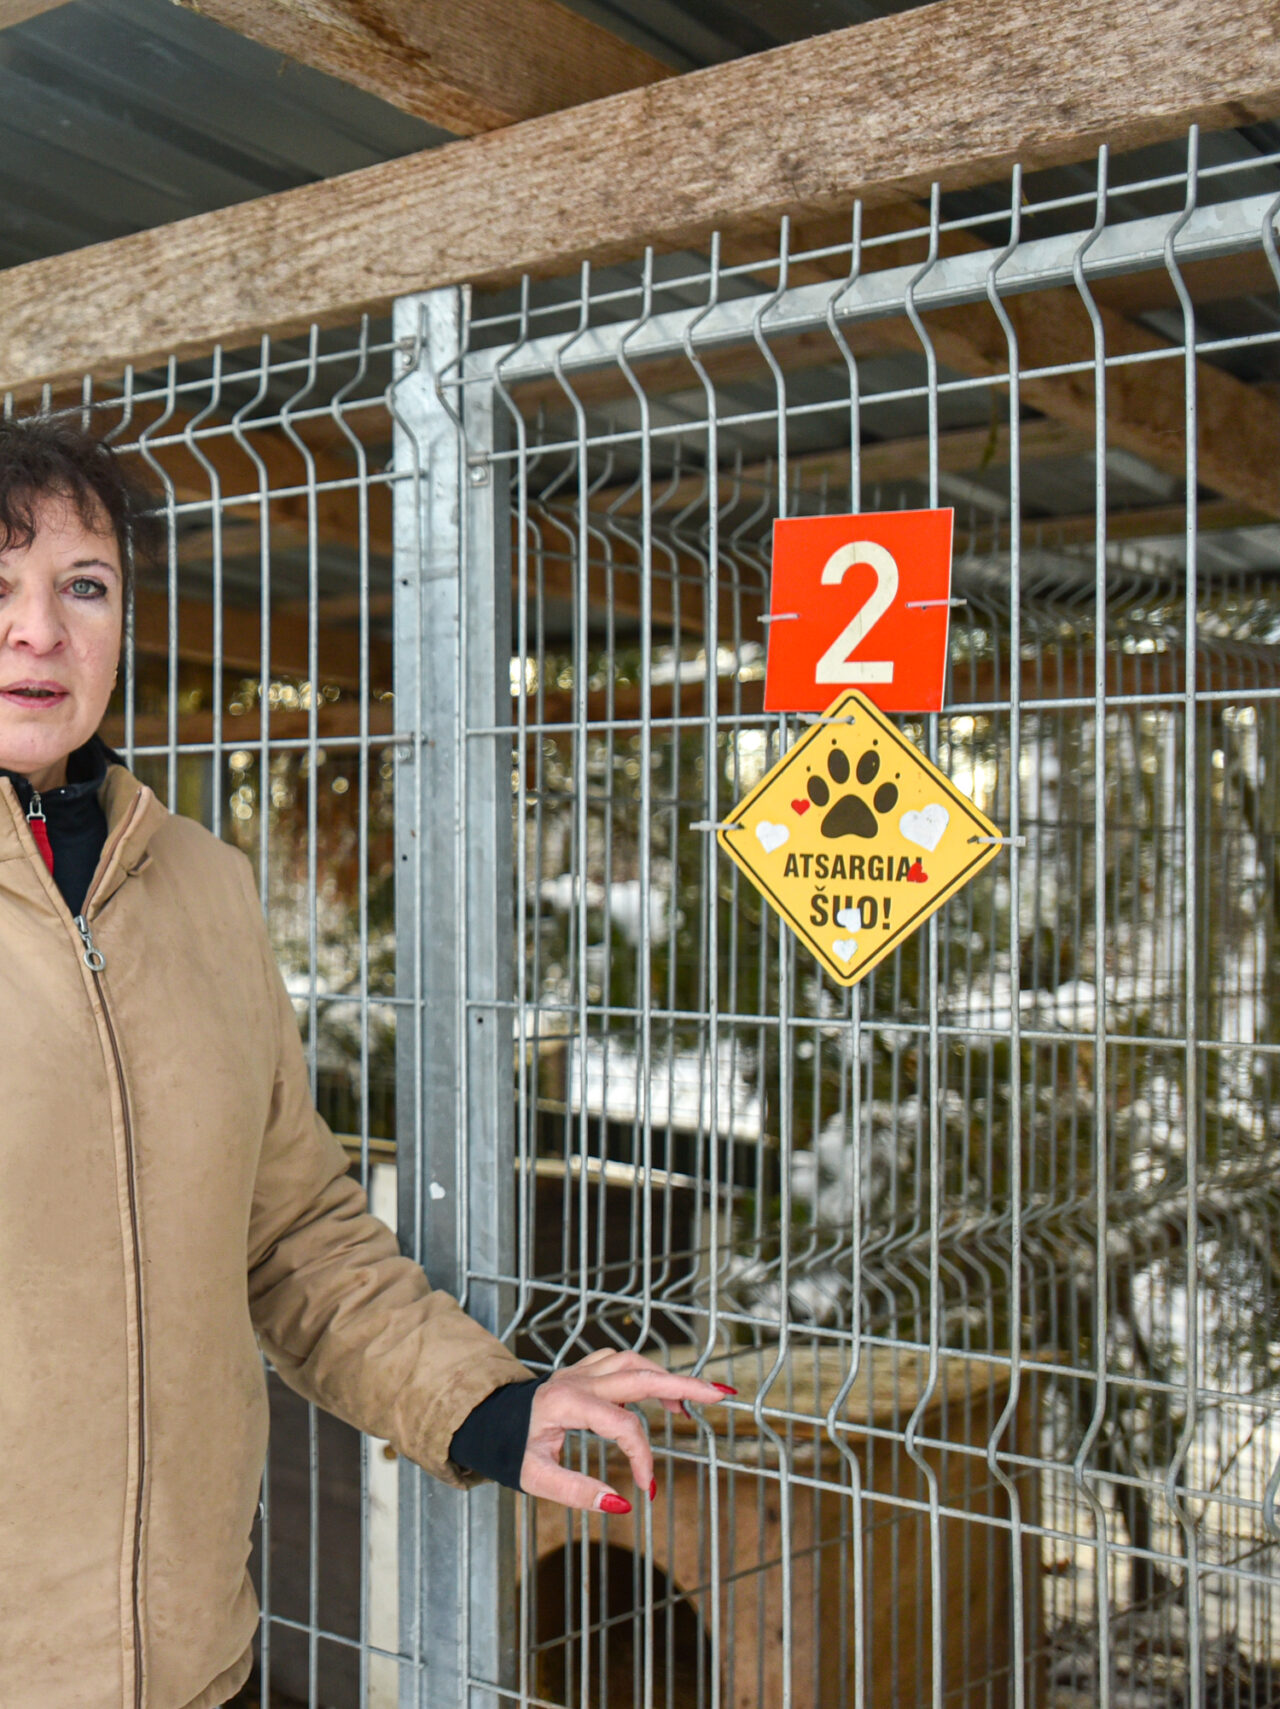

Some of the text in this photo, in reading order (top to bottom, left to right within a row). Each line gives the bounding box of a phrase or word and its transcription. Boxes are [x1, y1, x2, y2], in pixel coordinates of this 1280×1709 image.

[815, 541, 899, 684] 2
[784, 853, 923, 883] ATSARGIA
[810, 885, 891, 930] ŠUO!
